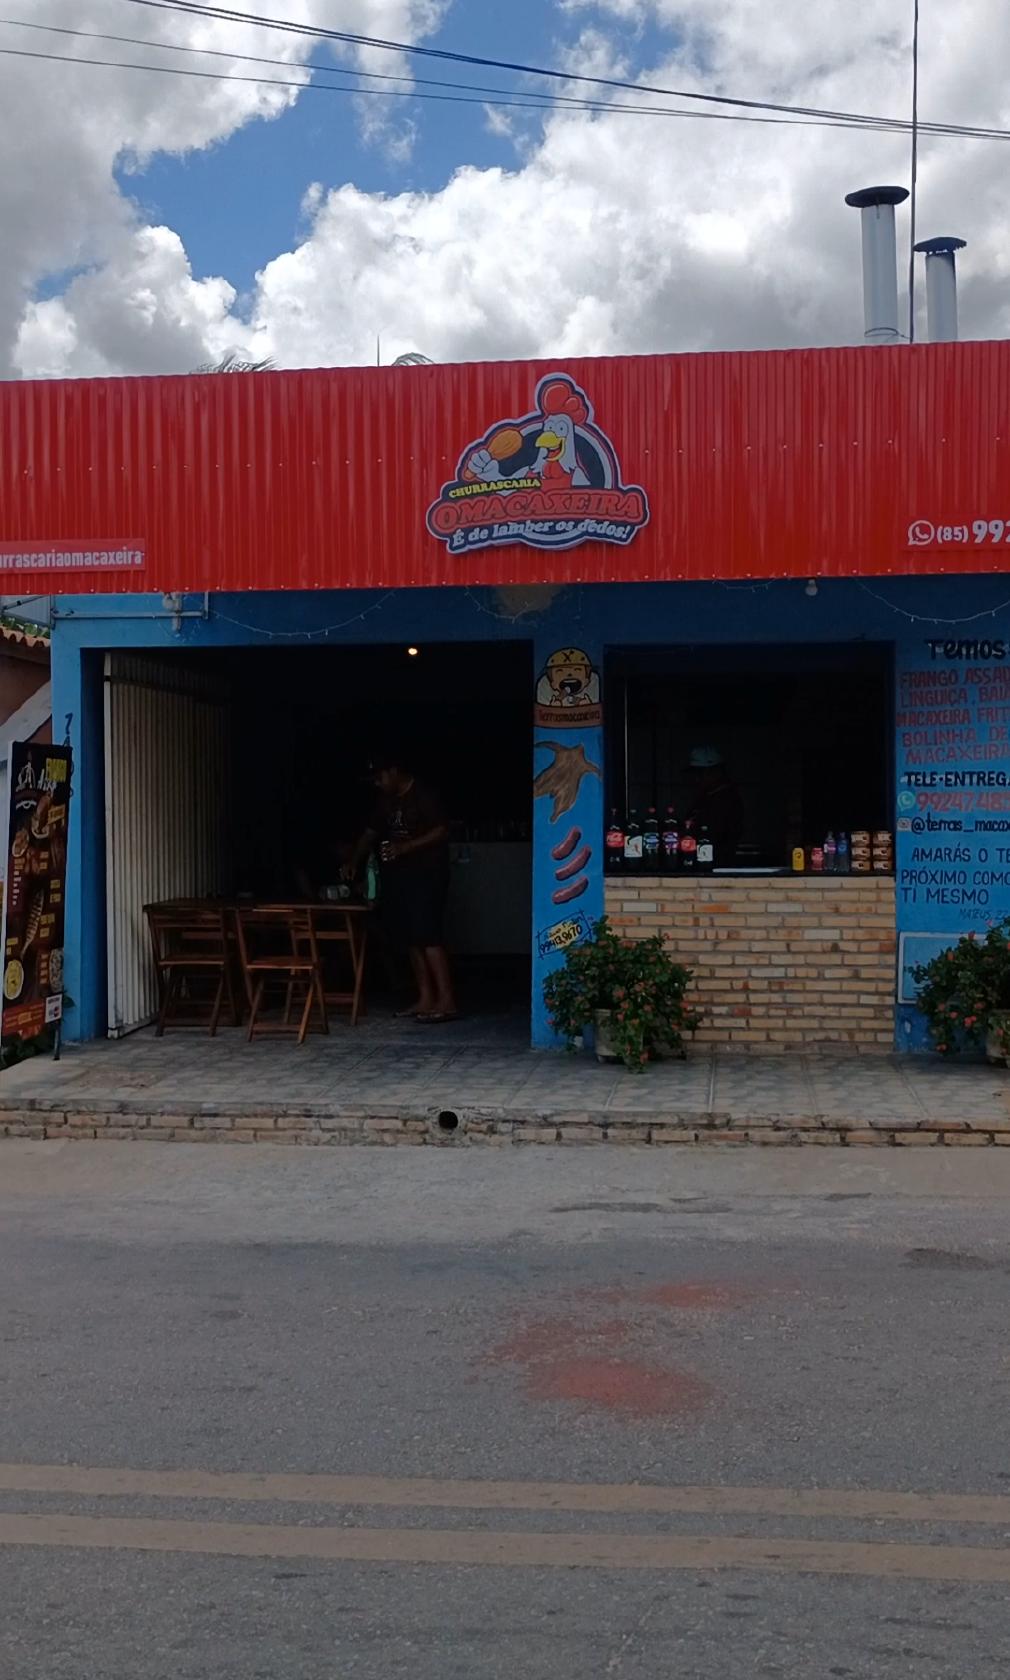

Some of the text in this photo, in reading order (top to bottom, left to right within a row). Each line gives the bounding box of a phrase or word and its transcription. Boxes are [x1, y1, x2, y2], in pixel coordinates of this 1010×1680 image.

[448, 478, 541, 498] CHURRASCARIA
[452, 518, 631, 548] É de lamber os dedos!
[936, 525, 969, 544] (85)
[900, 669, 960, 689] FRANGO
[896, 709, 971, 728] MACAXEIRA
[902, 727, 1009, 748] BOLINHA DE
[911, 842, 971, 863] AMARÁS
[978, 848, 988, 863] O
[901, 866, 967, 885] PRÓXIMO
[901, 886, 989, 905] TI MESMO
